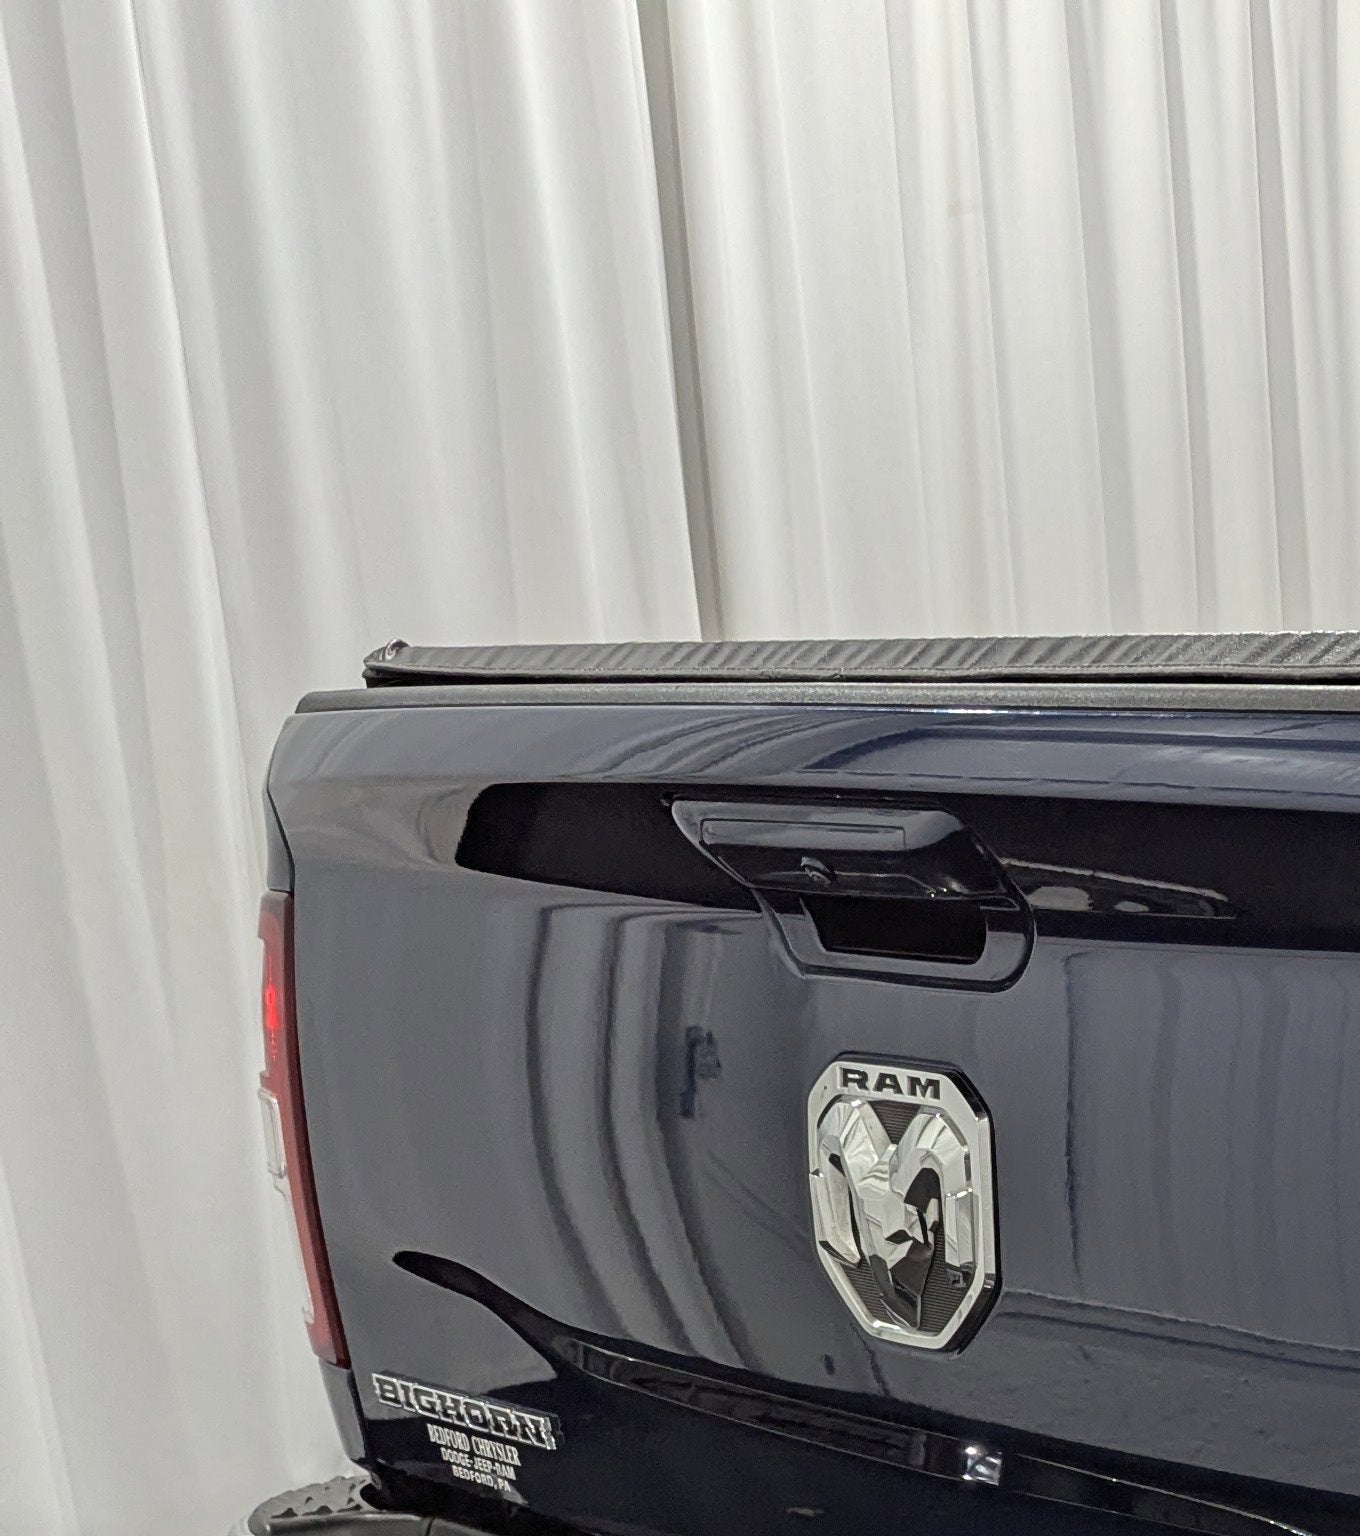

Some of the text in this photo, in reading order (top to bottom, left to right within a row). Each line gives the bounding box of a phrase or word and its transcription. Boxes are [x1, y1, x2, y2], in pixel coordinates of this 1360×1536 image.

[840, 1067, 940, 1100] RAM
[372, 1373, 557, 1450] BIGHORN
[427, 1423, 522, 1467] BEDFORD CHRYSLER
[497, 1477, 512, 1492] PA
